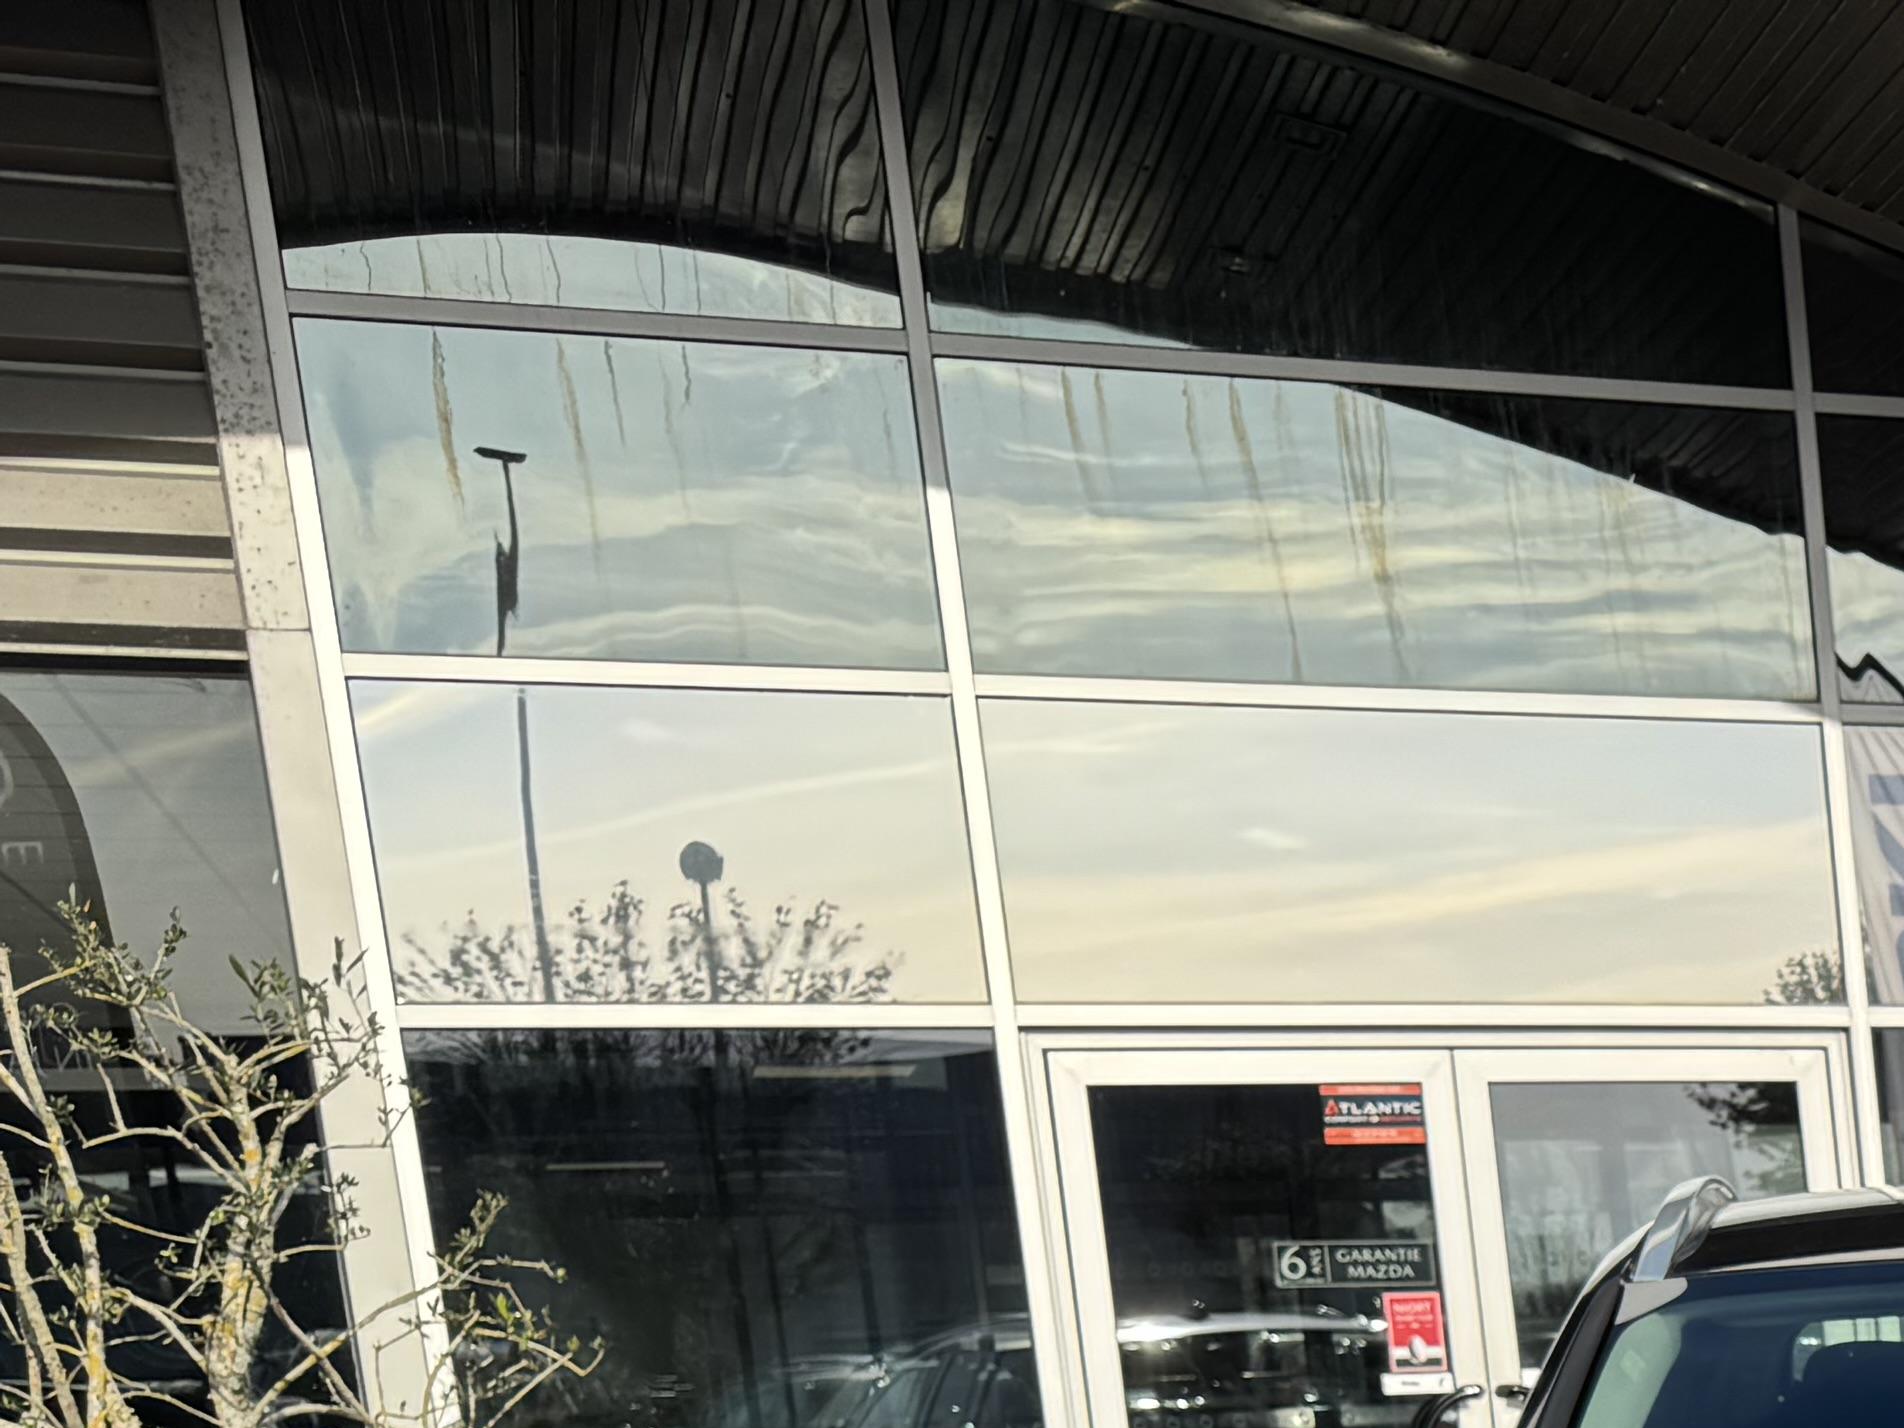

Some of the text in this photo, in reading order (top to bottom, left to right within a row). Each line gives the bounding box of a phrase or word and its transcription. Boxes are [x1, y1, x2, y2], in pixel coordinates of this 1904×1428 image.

[1324, 1099, 1422, 1116] ATLANTIC
[1281, 1245, 1307, 1281] 6
[1335, 1247, 1422, 1264] GARANTIE
[1347, 1265, 1416, 1279] MAZDA
